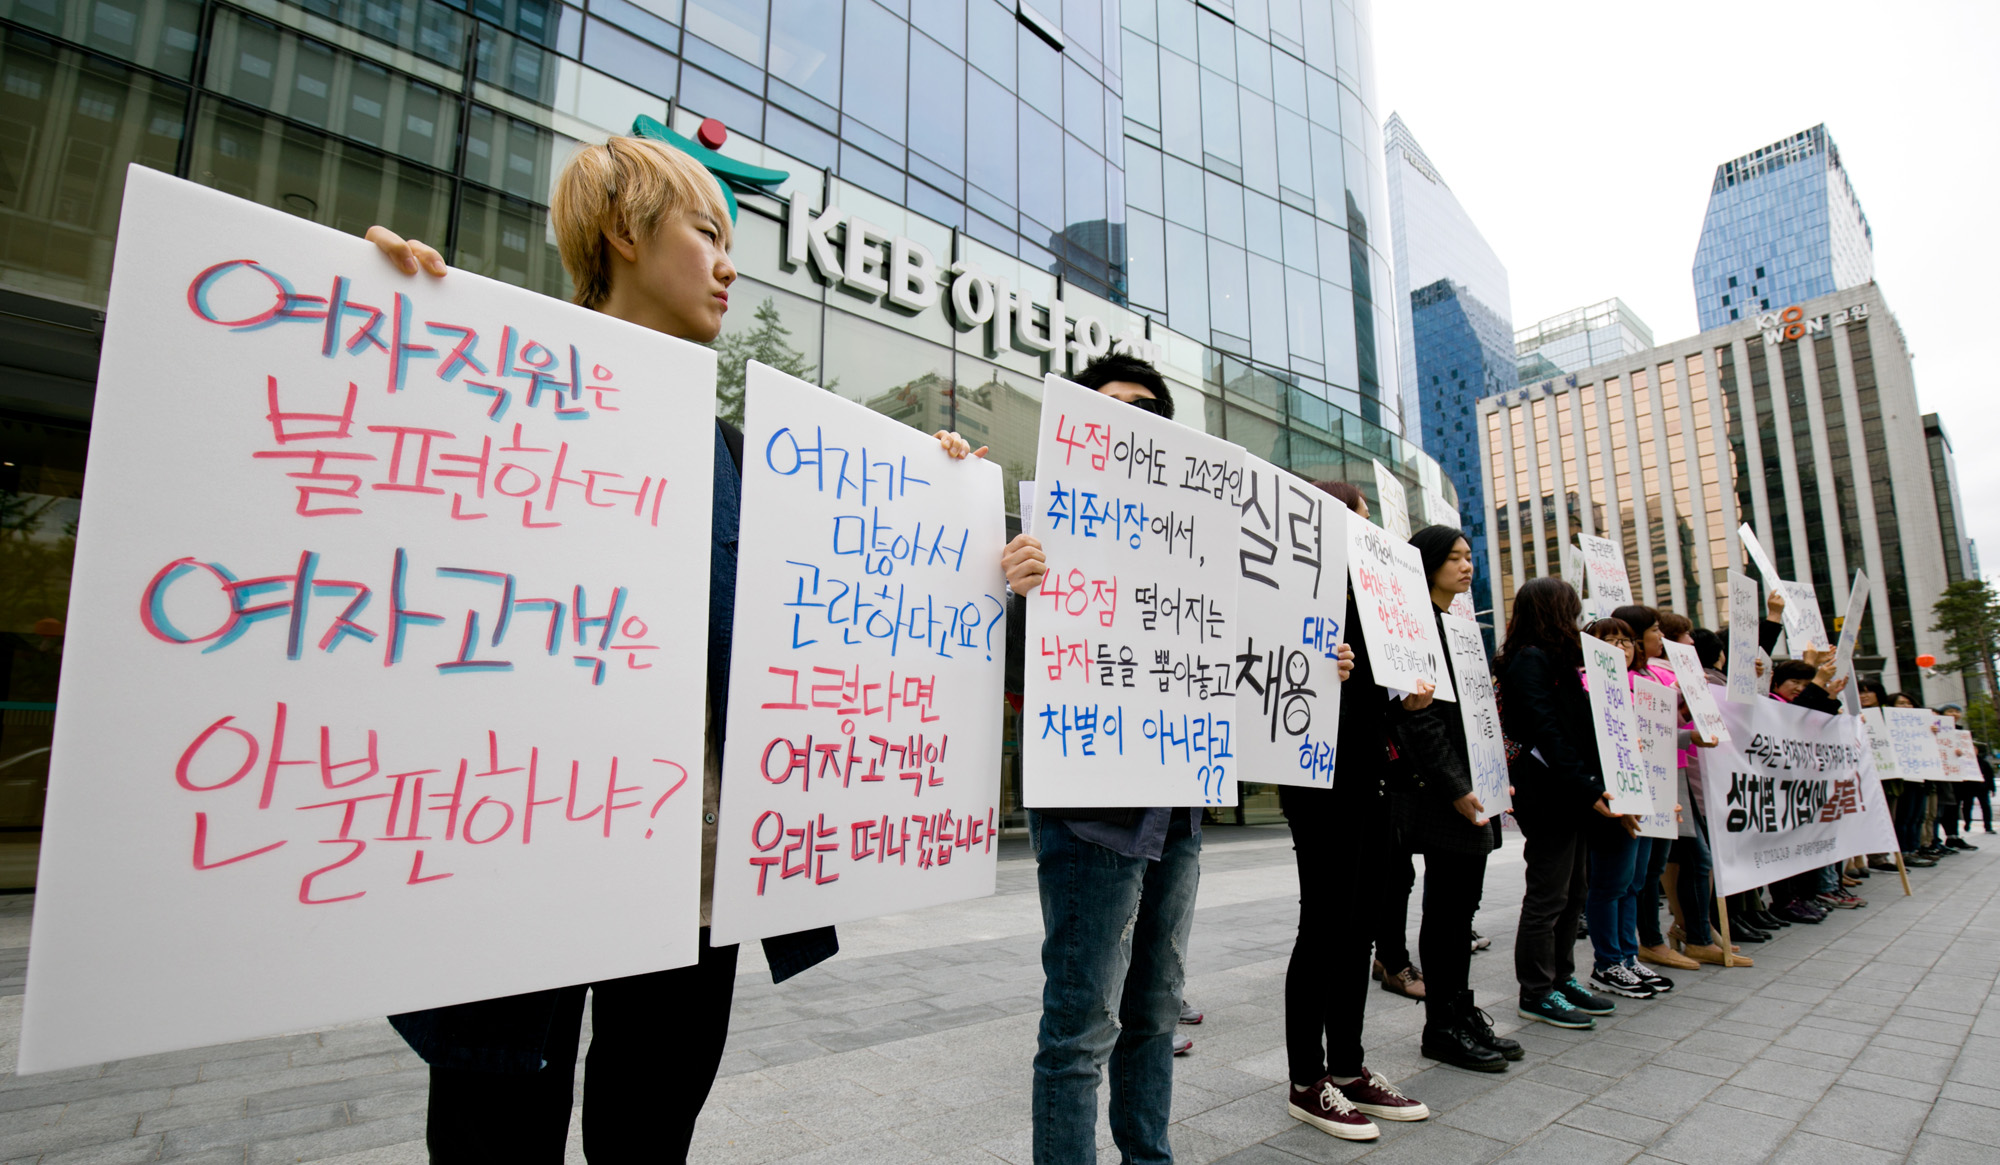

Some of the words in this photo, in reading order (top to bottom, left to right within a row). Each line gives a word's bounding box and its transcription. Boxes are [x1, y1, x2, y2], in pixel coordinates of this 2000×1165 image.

[187, 259, 620, 422] 여자직원은
[1756, 306, 1803, 331] KYO
[1763, 316, 1824, 346] WON
[1831, 303, 1869, 327] 교원
[252, 375, 667, 528] 불편한데
[765, 425, 931, 506] 여자가
[1056, 414, 1168, 486] 4점이어도
[1179, 455, 1244, 508] 고소감인
[833, 506, 968, 577] 많아서
[1047, 480, 1205, 567] 취준시장에서,
[1241, 469, 1322, 599] 실력
[783, 560, 1004, 662] 곤란하다고요?
[1040, 568, 1118, 627] 48점
[1135, 583, 1225, 643] 떨어지는
[1360, 566, 1391, 601] 여자는
[140, 547, 659, 685] 여자고객은
[1302, 616, 1340, 660] 대로
[1378, 603, 1394, 635] 안
[761, 664, 939, 735] 그렇다면
[1041, 636, 1138, 687] 남자들을
[1150, 649, 1236, 700] 뽑아놓고
[1236, 637, 1318, 743] 채용
[760, 734, 947, 797] 여자고객인
[1040, 704, 1124, 757] 차별이
[1143, 709, 1233, 765] 아니라고
[1300, 733, 1335, 783] 하라
[1745, 733, 1782, 768] 우리는
[1197, 765, 1226, 804] ??
[1616, 770, 1643, 795] 아니다
[1726, 772, 1778, 833] 성차별
[1780, 779, 1828, 831] 기업에
[749, 810, 840, 896] 우리는
[851, 807, 996, 871] 떠나겠습니다
